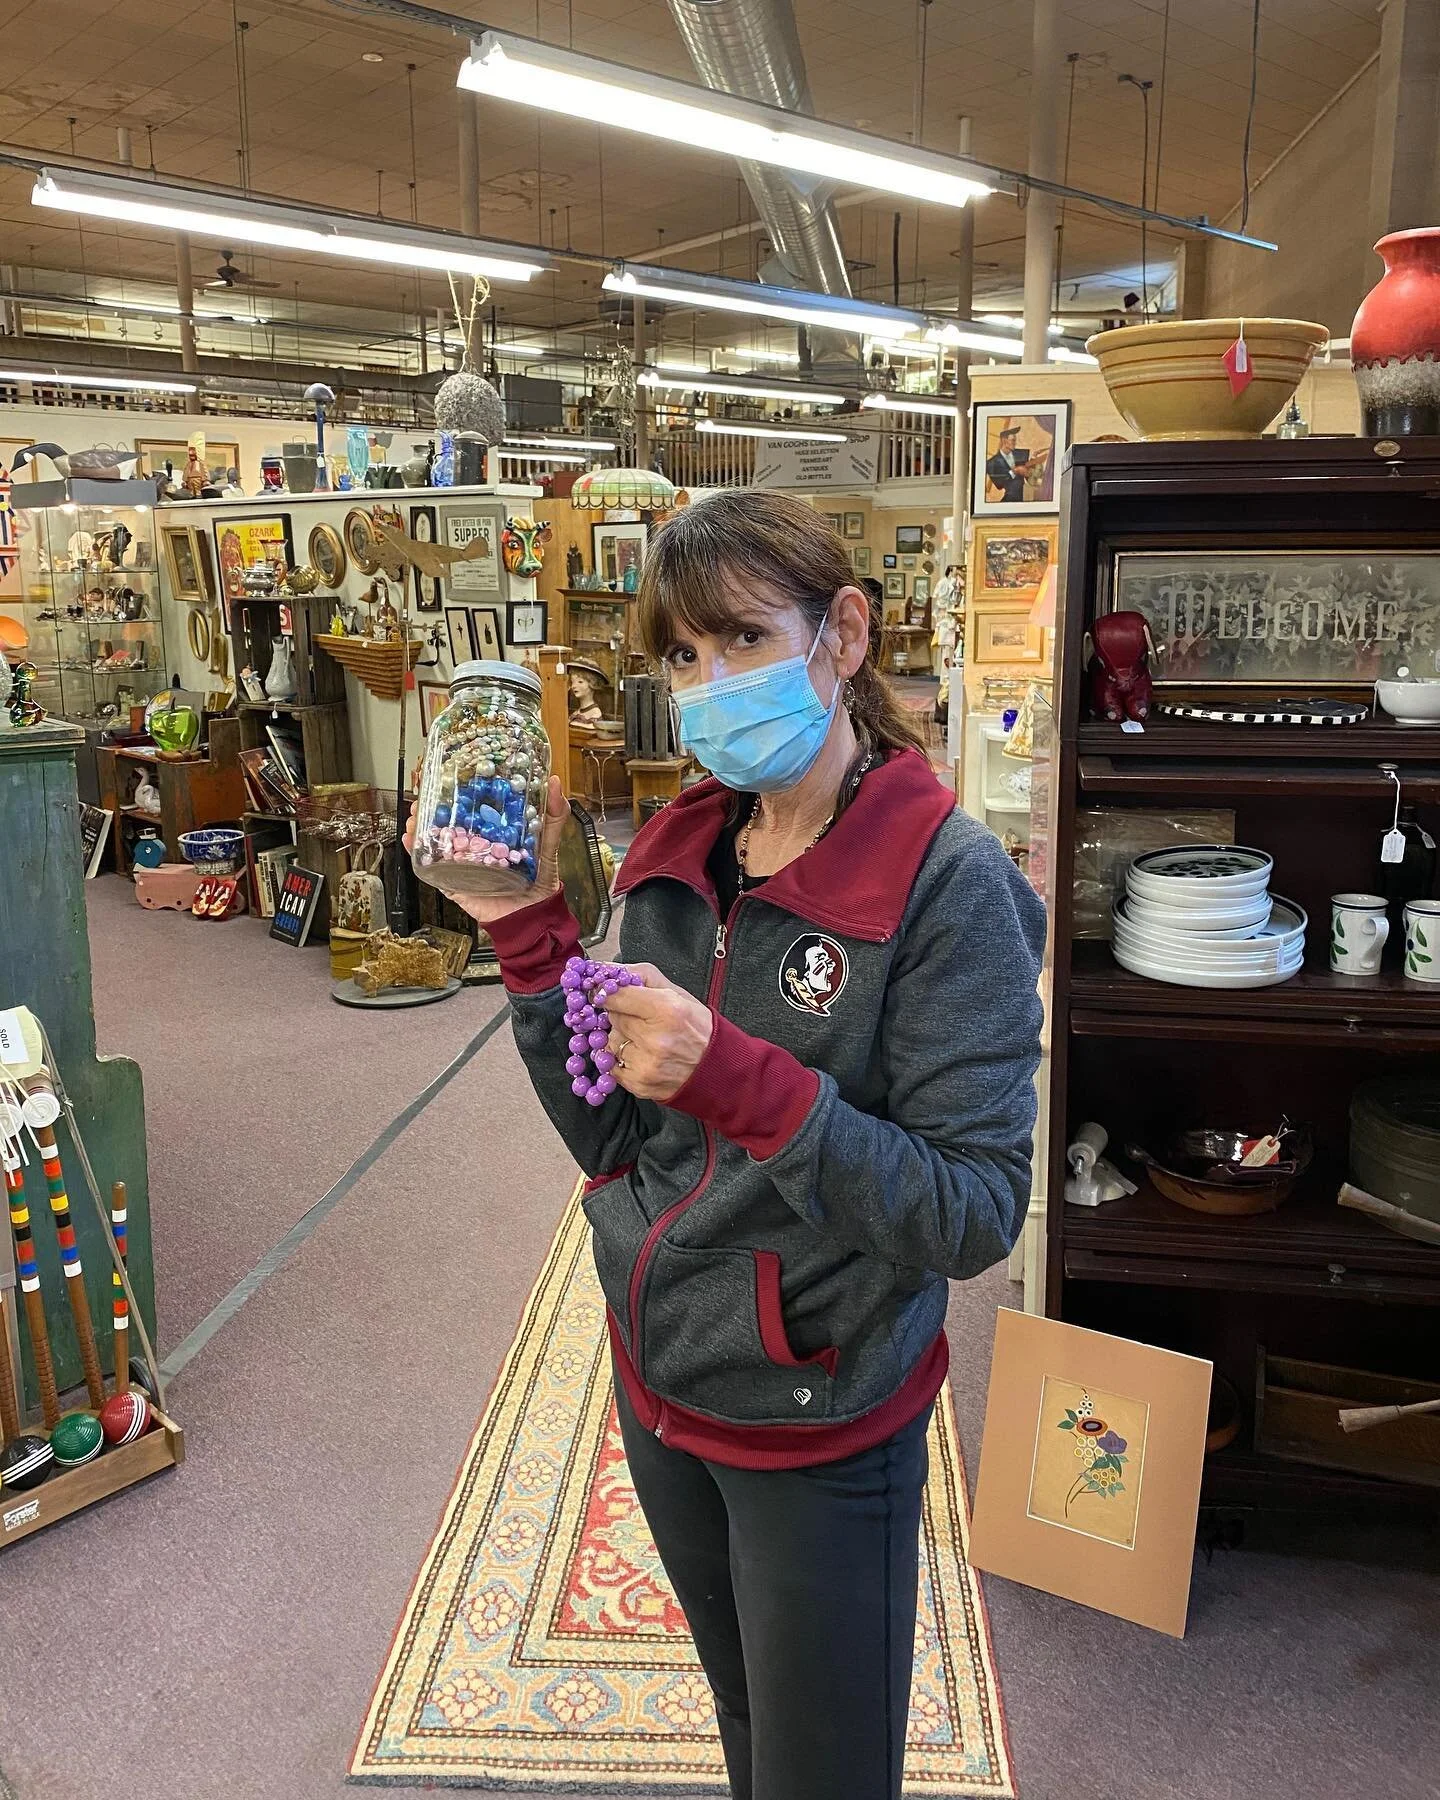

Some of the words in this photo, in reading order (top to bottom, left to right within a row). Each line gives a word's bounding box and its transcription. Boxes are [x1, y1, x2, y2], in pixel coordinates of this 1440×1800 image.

[767, 441, 782, 449] VAN
[849, 434, 871, 444] SHOP
[249, 527, 275, 538] OZARK
[454, 527, 490, 542] SUPPER
[1166, 584, 1401, 648] WELCOME
[279, 891, 306, 917] ICAN
[0, 1028, 10, 1049] SOLD
